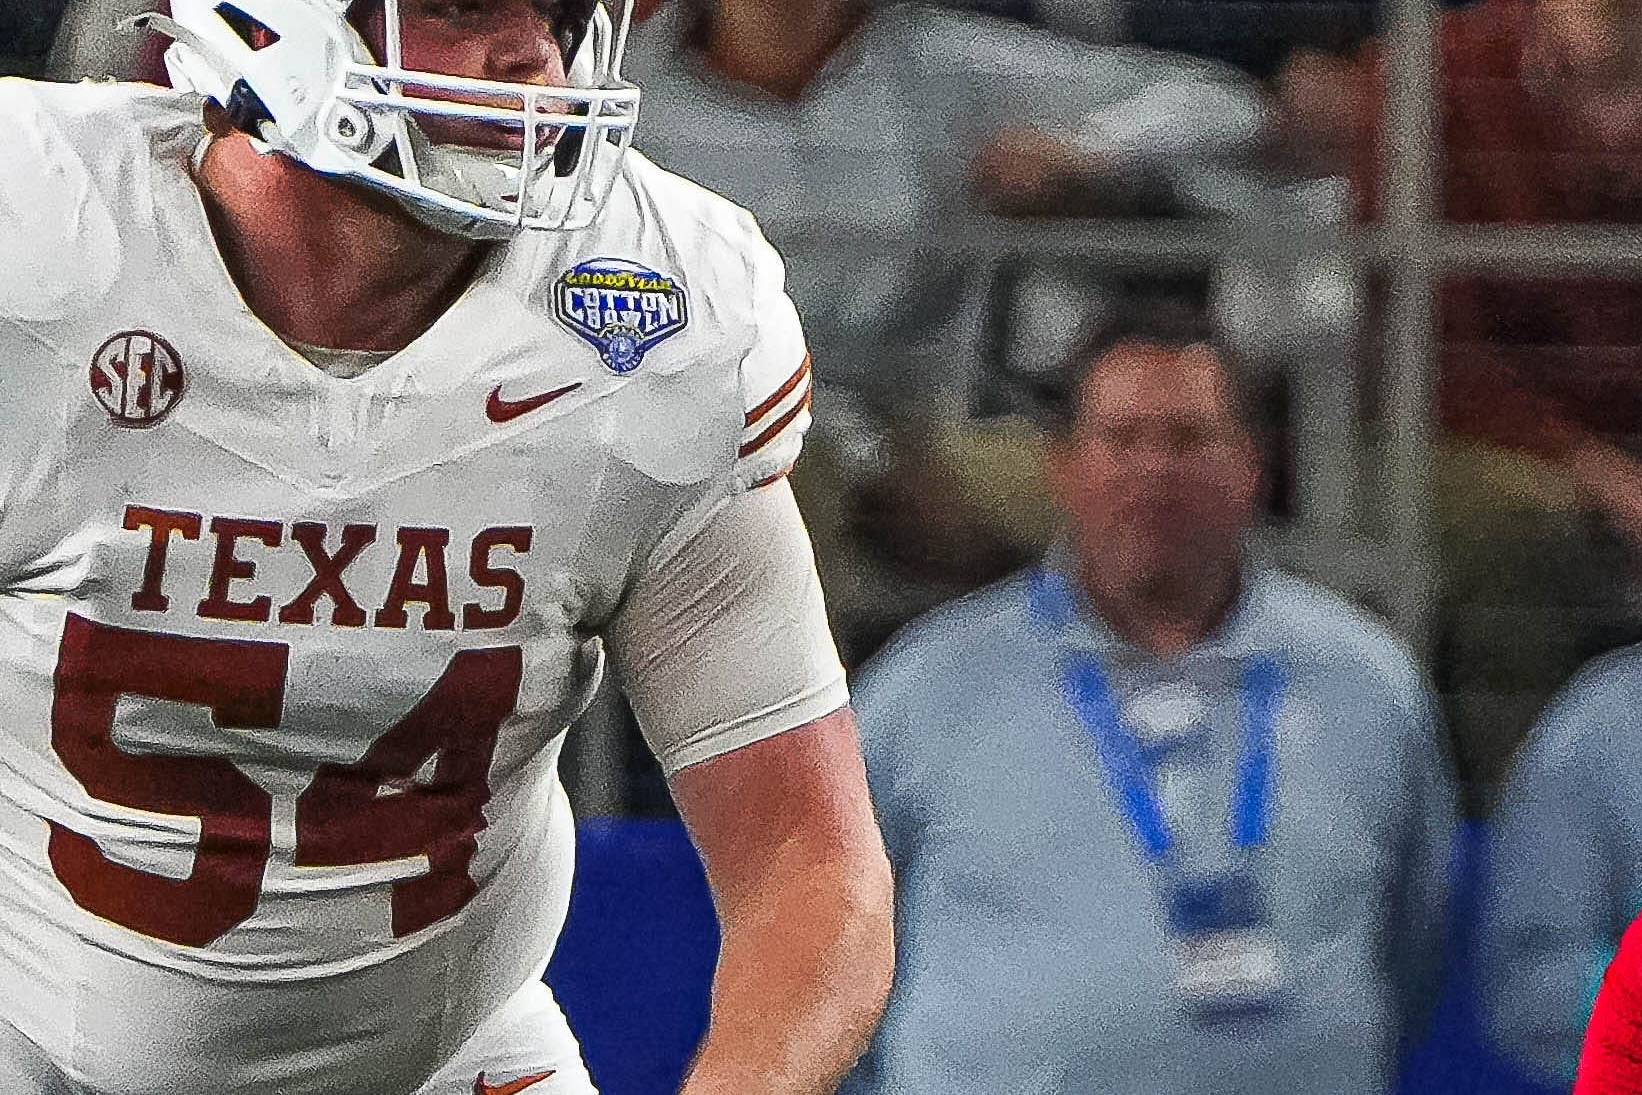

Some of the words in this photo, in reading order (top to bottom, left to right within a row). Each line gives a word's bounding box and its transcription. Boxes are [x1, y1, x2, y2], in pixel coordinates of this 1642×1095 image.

[95, 336, 178, 416] SEC
[122, 504, 534, 631] TEXAS
[46, 612, 524, 948] 54
